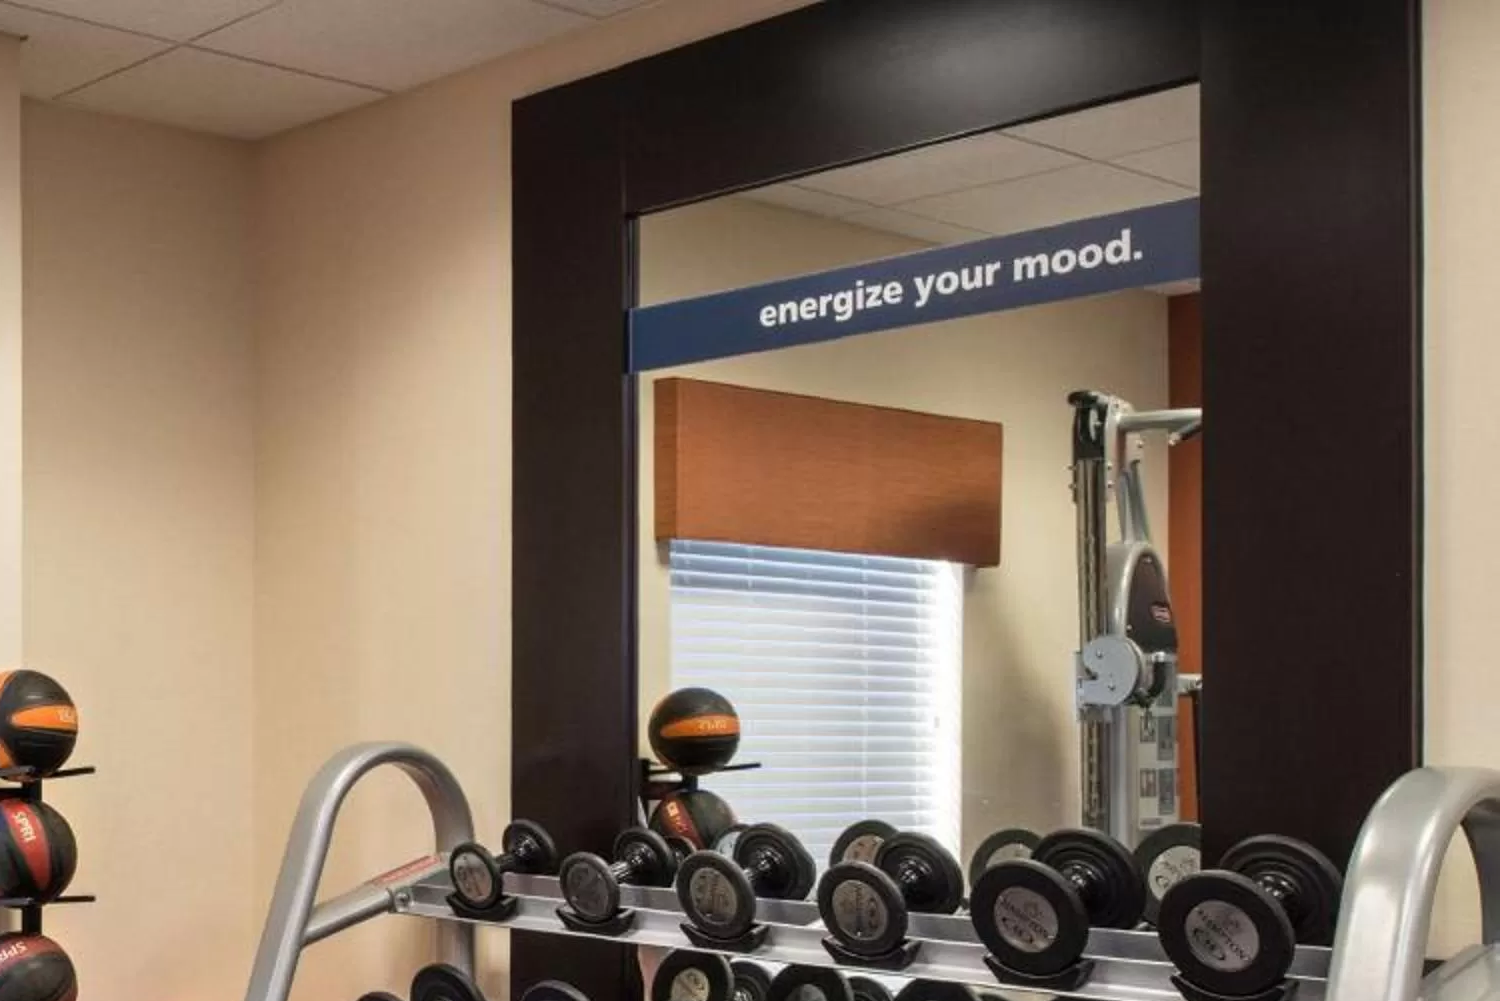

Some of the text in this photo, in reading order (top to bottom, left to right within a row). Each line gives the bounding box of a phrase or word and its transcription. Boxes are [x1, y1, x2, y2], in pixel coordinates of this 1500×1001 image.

[759, 228, 1143, 328] energize your mood.
[12, 810, 37, 844] SPRI
